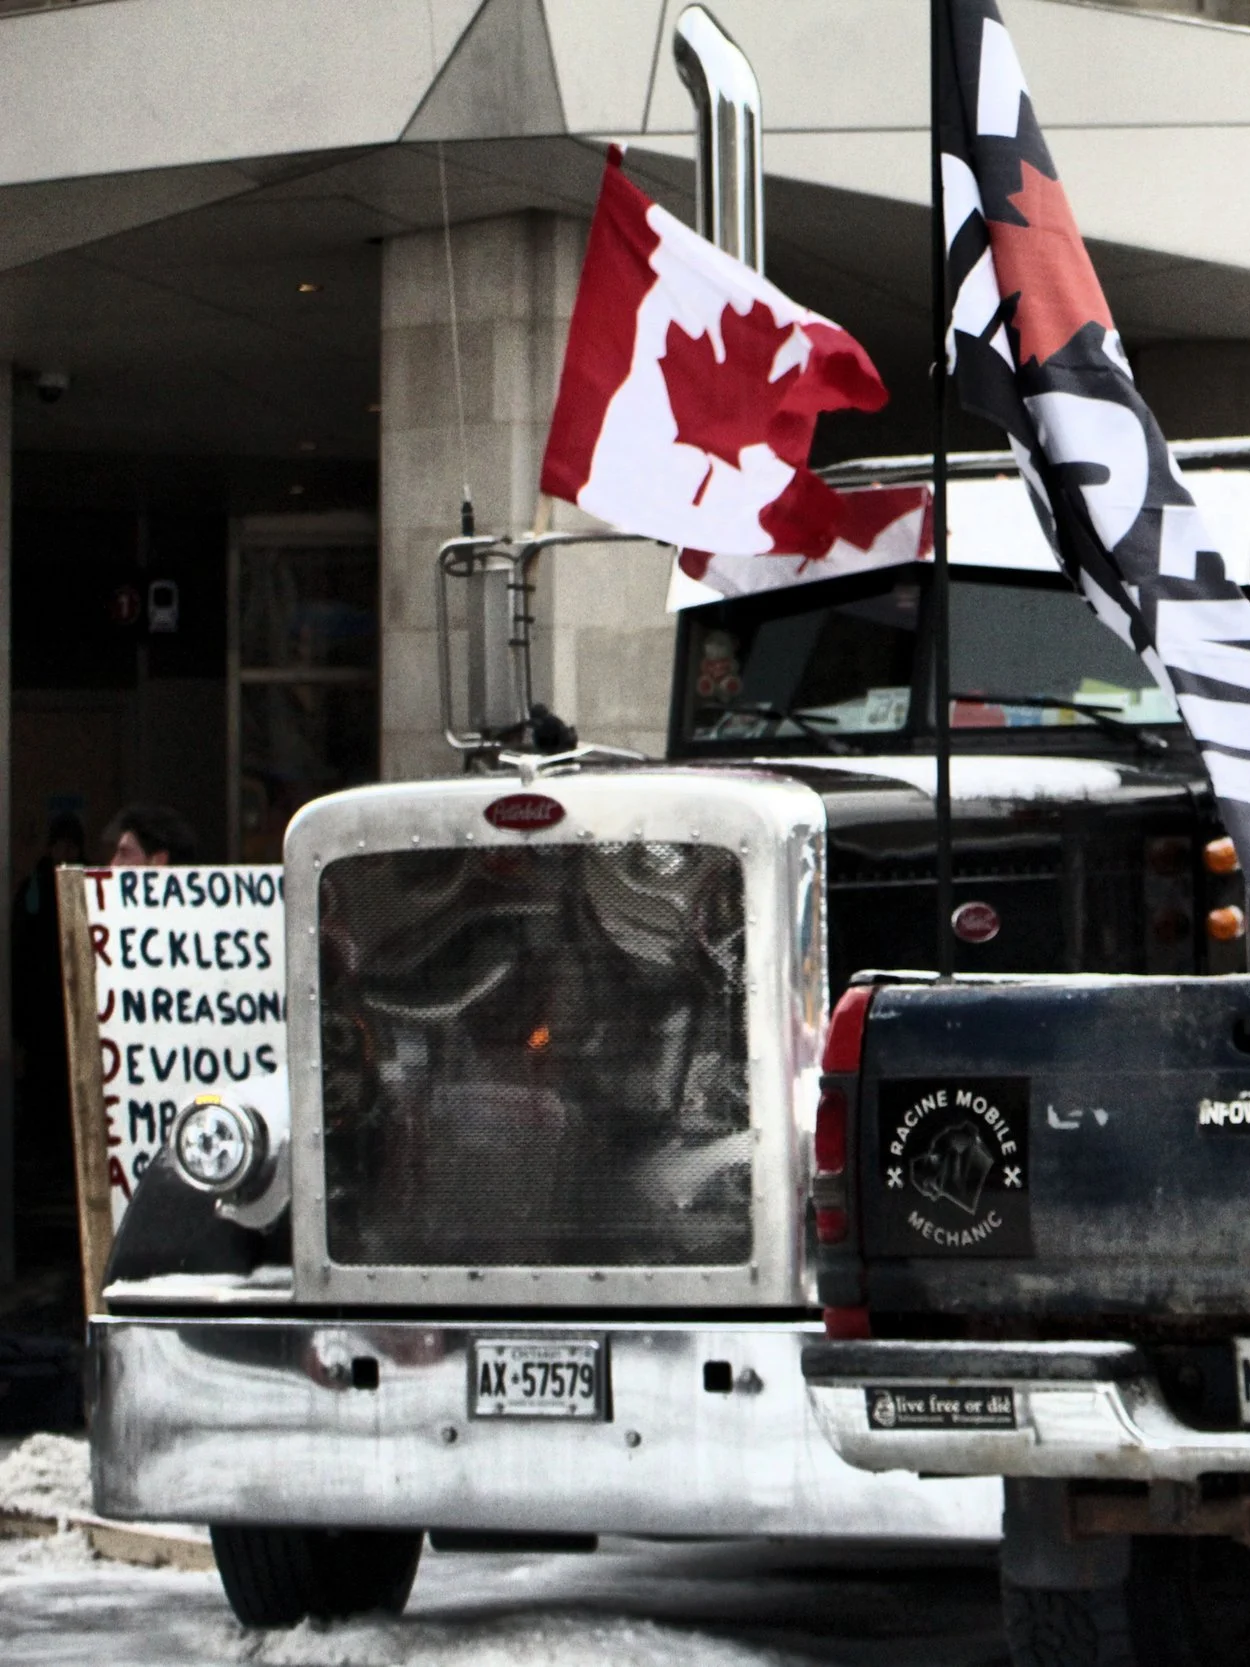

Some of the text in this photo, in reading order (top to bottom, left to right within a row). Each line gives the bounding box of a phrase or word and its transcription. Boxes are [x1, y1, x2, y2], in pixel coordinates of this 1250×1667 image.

[84, 871, 285, 911] TREASONO
[89, 924, 271, 969] RECKLESS
[98, 988, 287, 1024] UNREASON
[890, 1089, 1017, 1156] RACINE MOBILE
[908, 1210, 1003, 1247] MECHANIC
[964, 1400, 983, 1413] or
